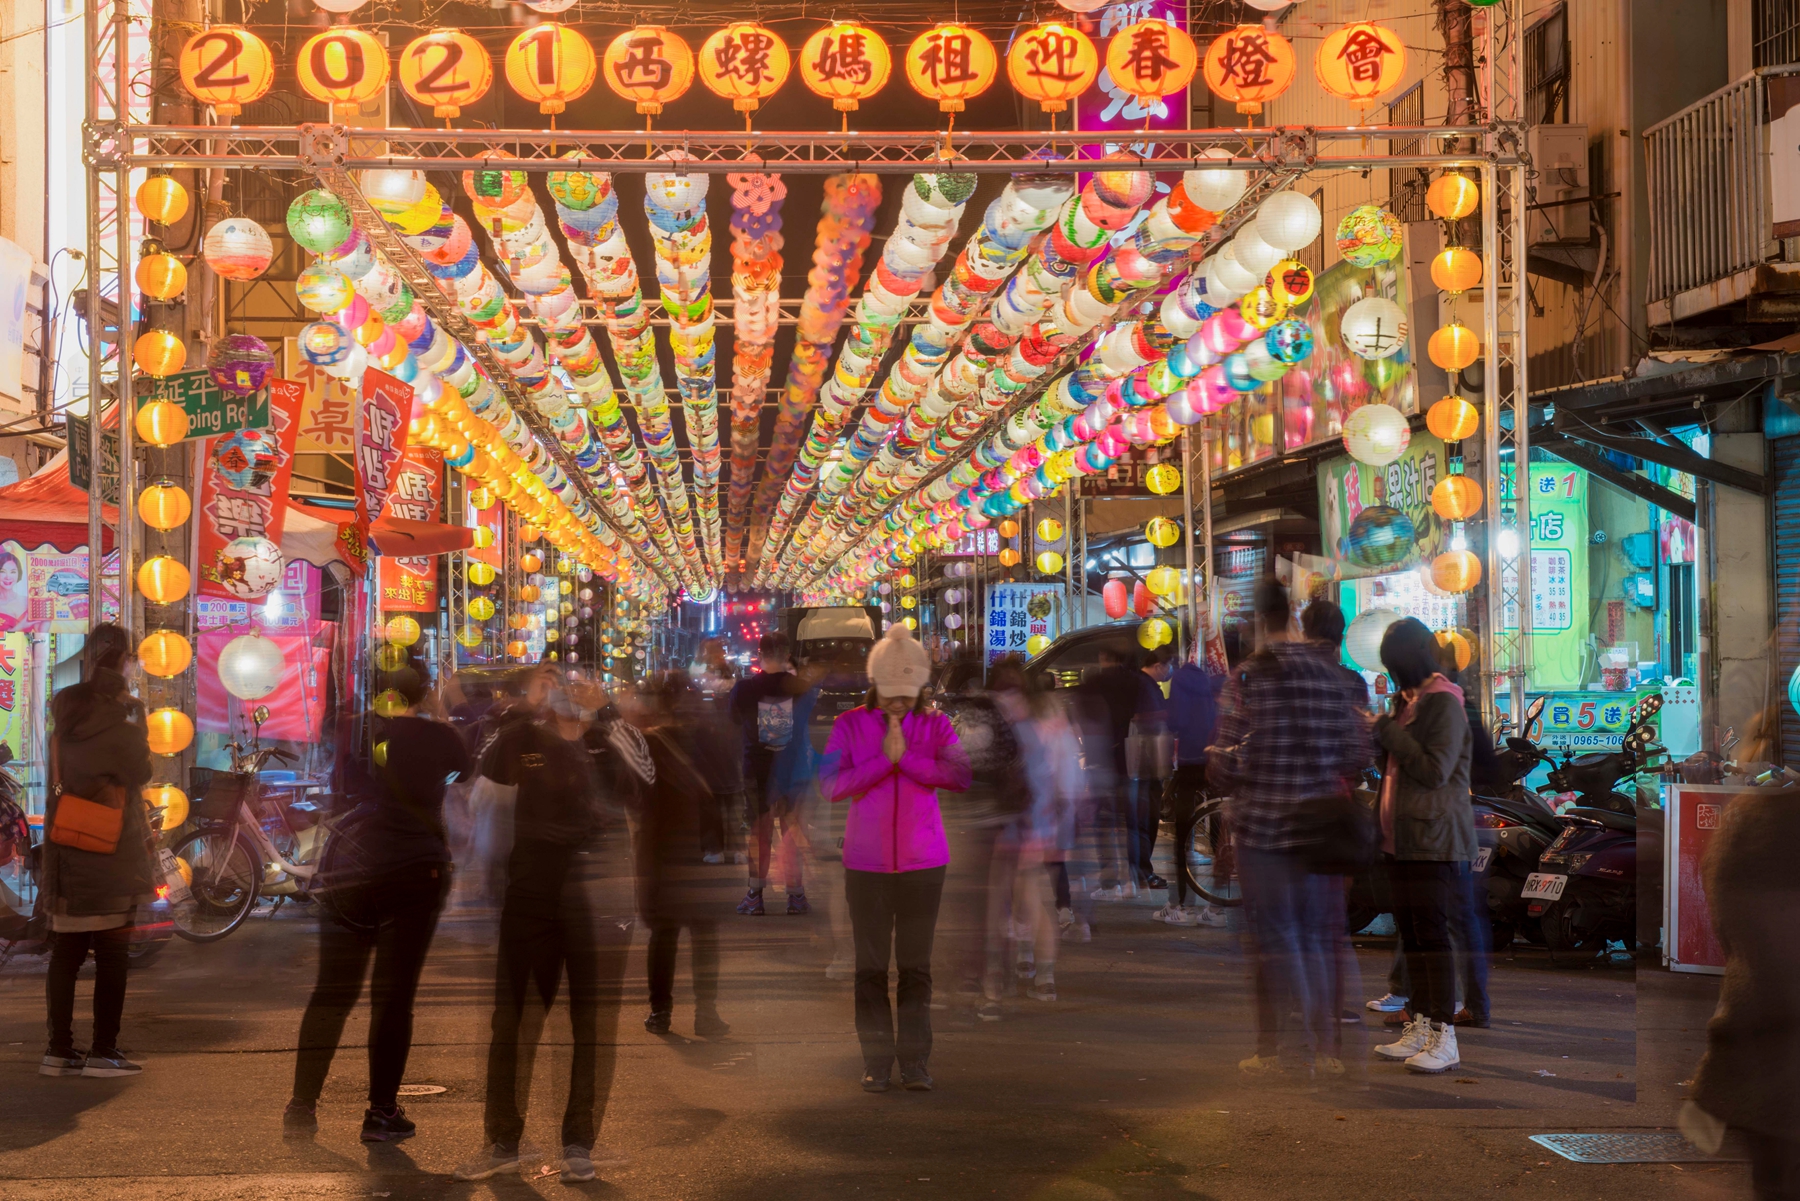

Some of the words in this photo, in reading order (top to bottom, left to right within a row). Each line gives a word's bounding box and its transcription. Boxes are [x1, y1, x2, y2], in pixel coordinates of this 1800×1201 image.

[186, 411, 221, 436] ping
[227, 403, 253, 425] Rd.
[226, 449, 245, 469] 春
[1388, 456, 1437, 508] 果汁店
[1549, 587, 1556, 596] 35
[1558, 587, 1566, 596] 35
